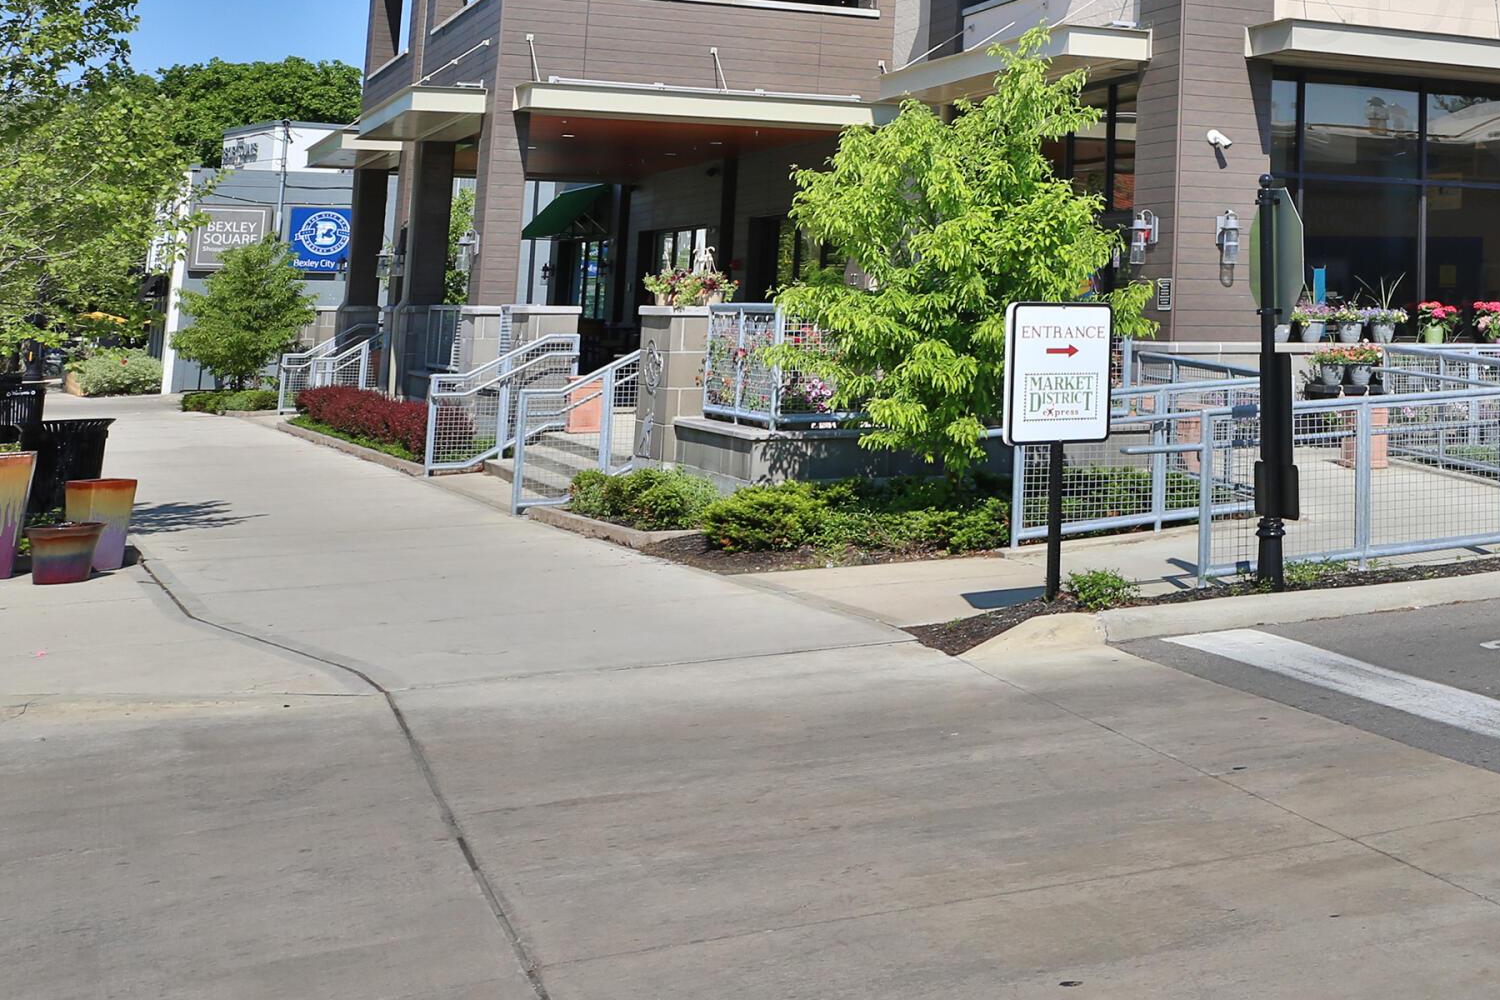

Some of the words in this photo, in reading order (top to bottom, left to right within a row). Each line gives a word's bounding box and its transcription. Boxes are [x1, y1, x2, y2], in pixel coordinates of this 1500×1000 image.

[207, 221, 257, 232] BEXLEY
[293, 259, 319, 268] Bexley
[320, 259, 336, 268] City
[1022, 326, 1105, 339] ENTRANCE
[1030, 376, 1093, 390] MARKET
[1029, 391, 1093, 412] DISTRICT
